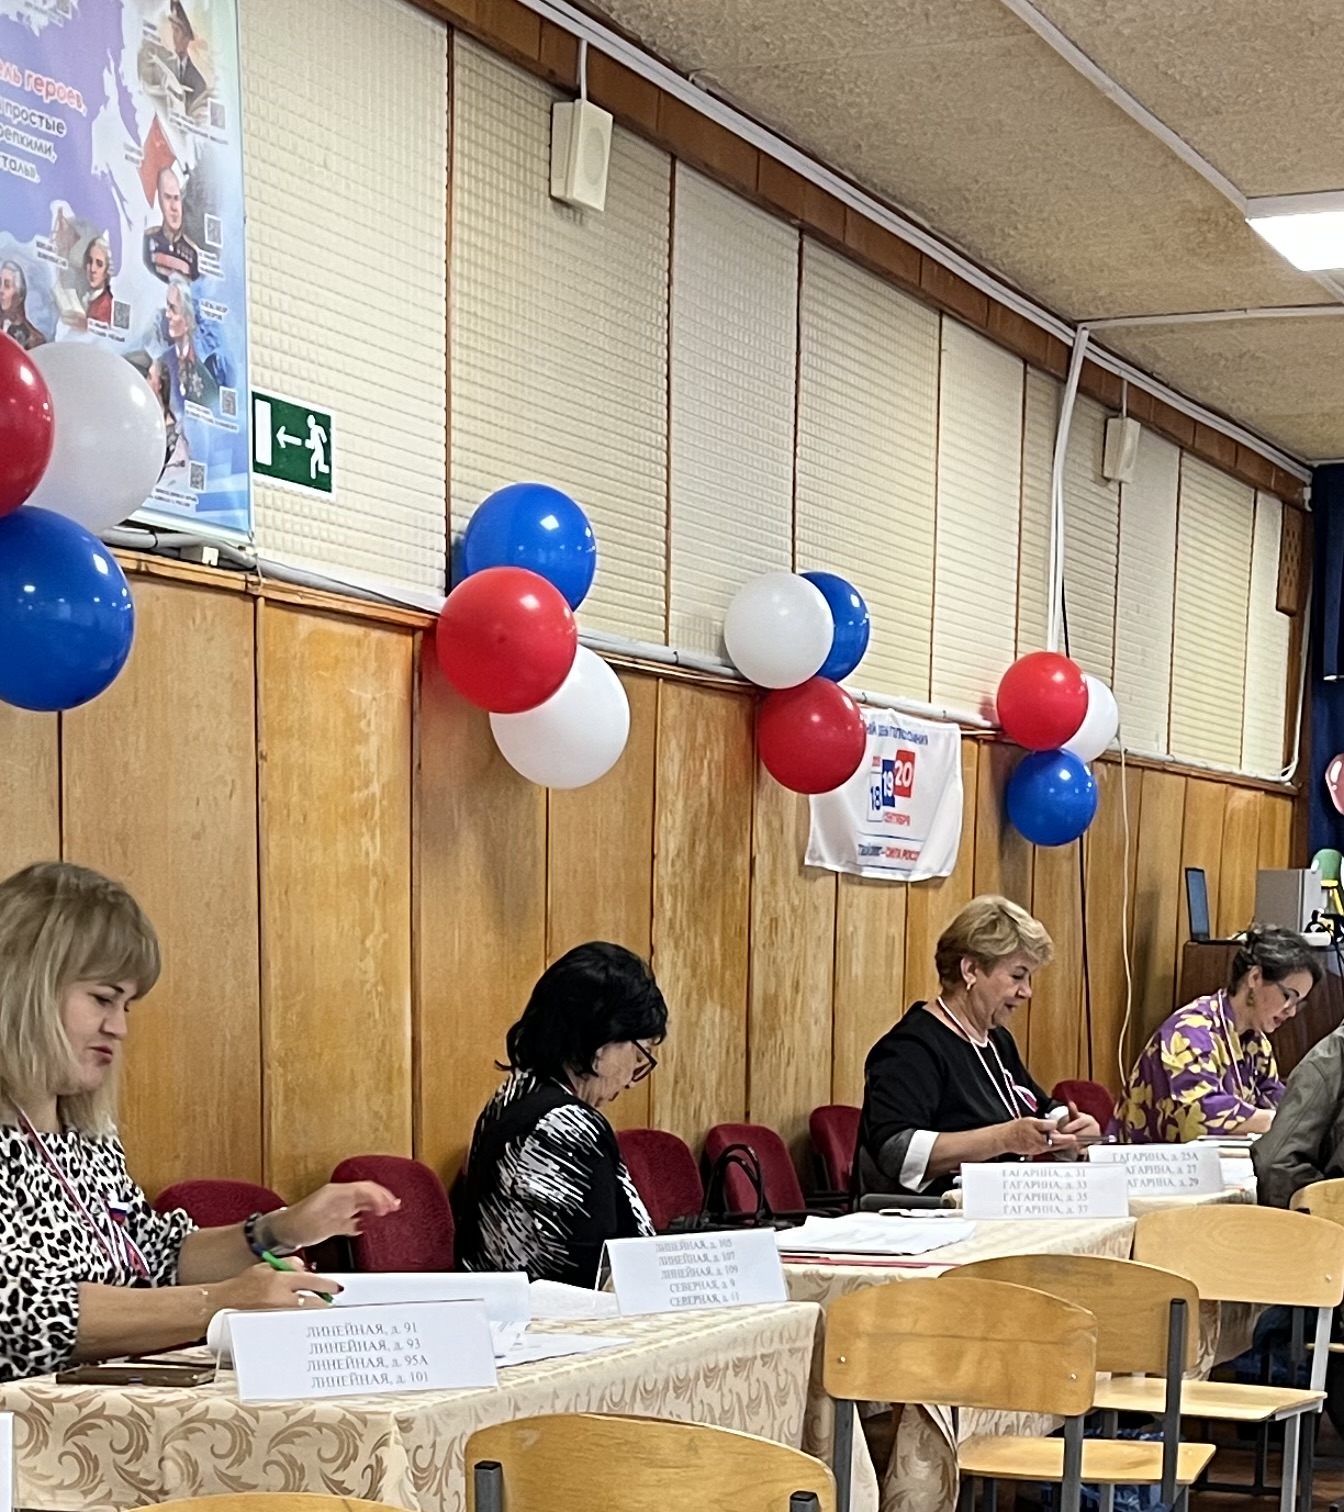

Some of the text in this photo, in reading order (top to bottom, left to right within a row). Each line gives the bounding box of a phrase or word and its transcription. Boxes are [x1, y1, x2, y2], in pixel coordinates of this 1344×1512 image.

[26, 72, 86, 114] героев,
[6, 101, 66, 134] простые
[870, 785, 882, 811] 18
[882, 770, 895, 798] 19
[894, 759, 913, 788] 20
[1126, 1164, 1175, 1175] АГАРИНА,
[1127, 1178, 1177, 1188] АГАРИНА,
[306, 1321, 389, 1338] ЛИНЕЙНАЯ,
[403, 1321, 417, 1333] 91
[309, 1338, 391, 1355] ЛИНЕЙНАЯ,
[406, 1337, 421, 1349] 93
[307, 1355, 389, 1372] ЛИНЕЙНАЯ,
[404, 1354, 429, 1367] 95А
[311, 1372, 394, 1389] ЛИНЕЙНАЯ,
[409, 1371, 428, 1383] 101
